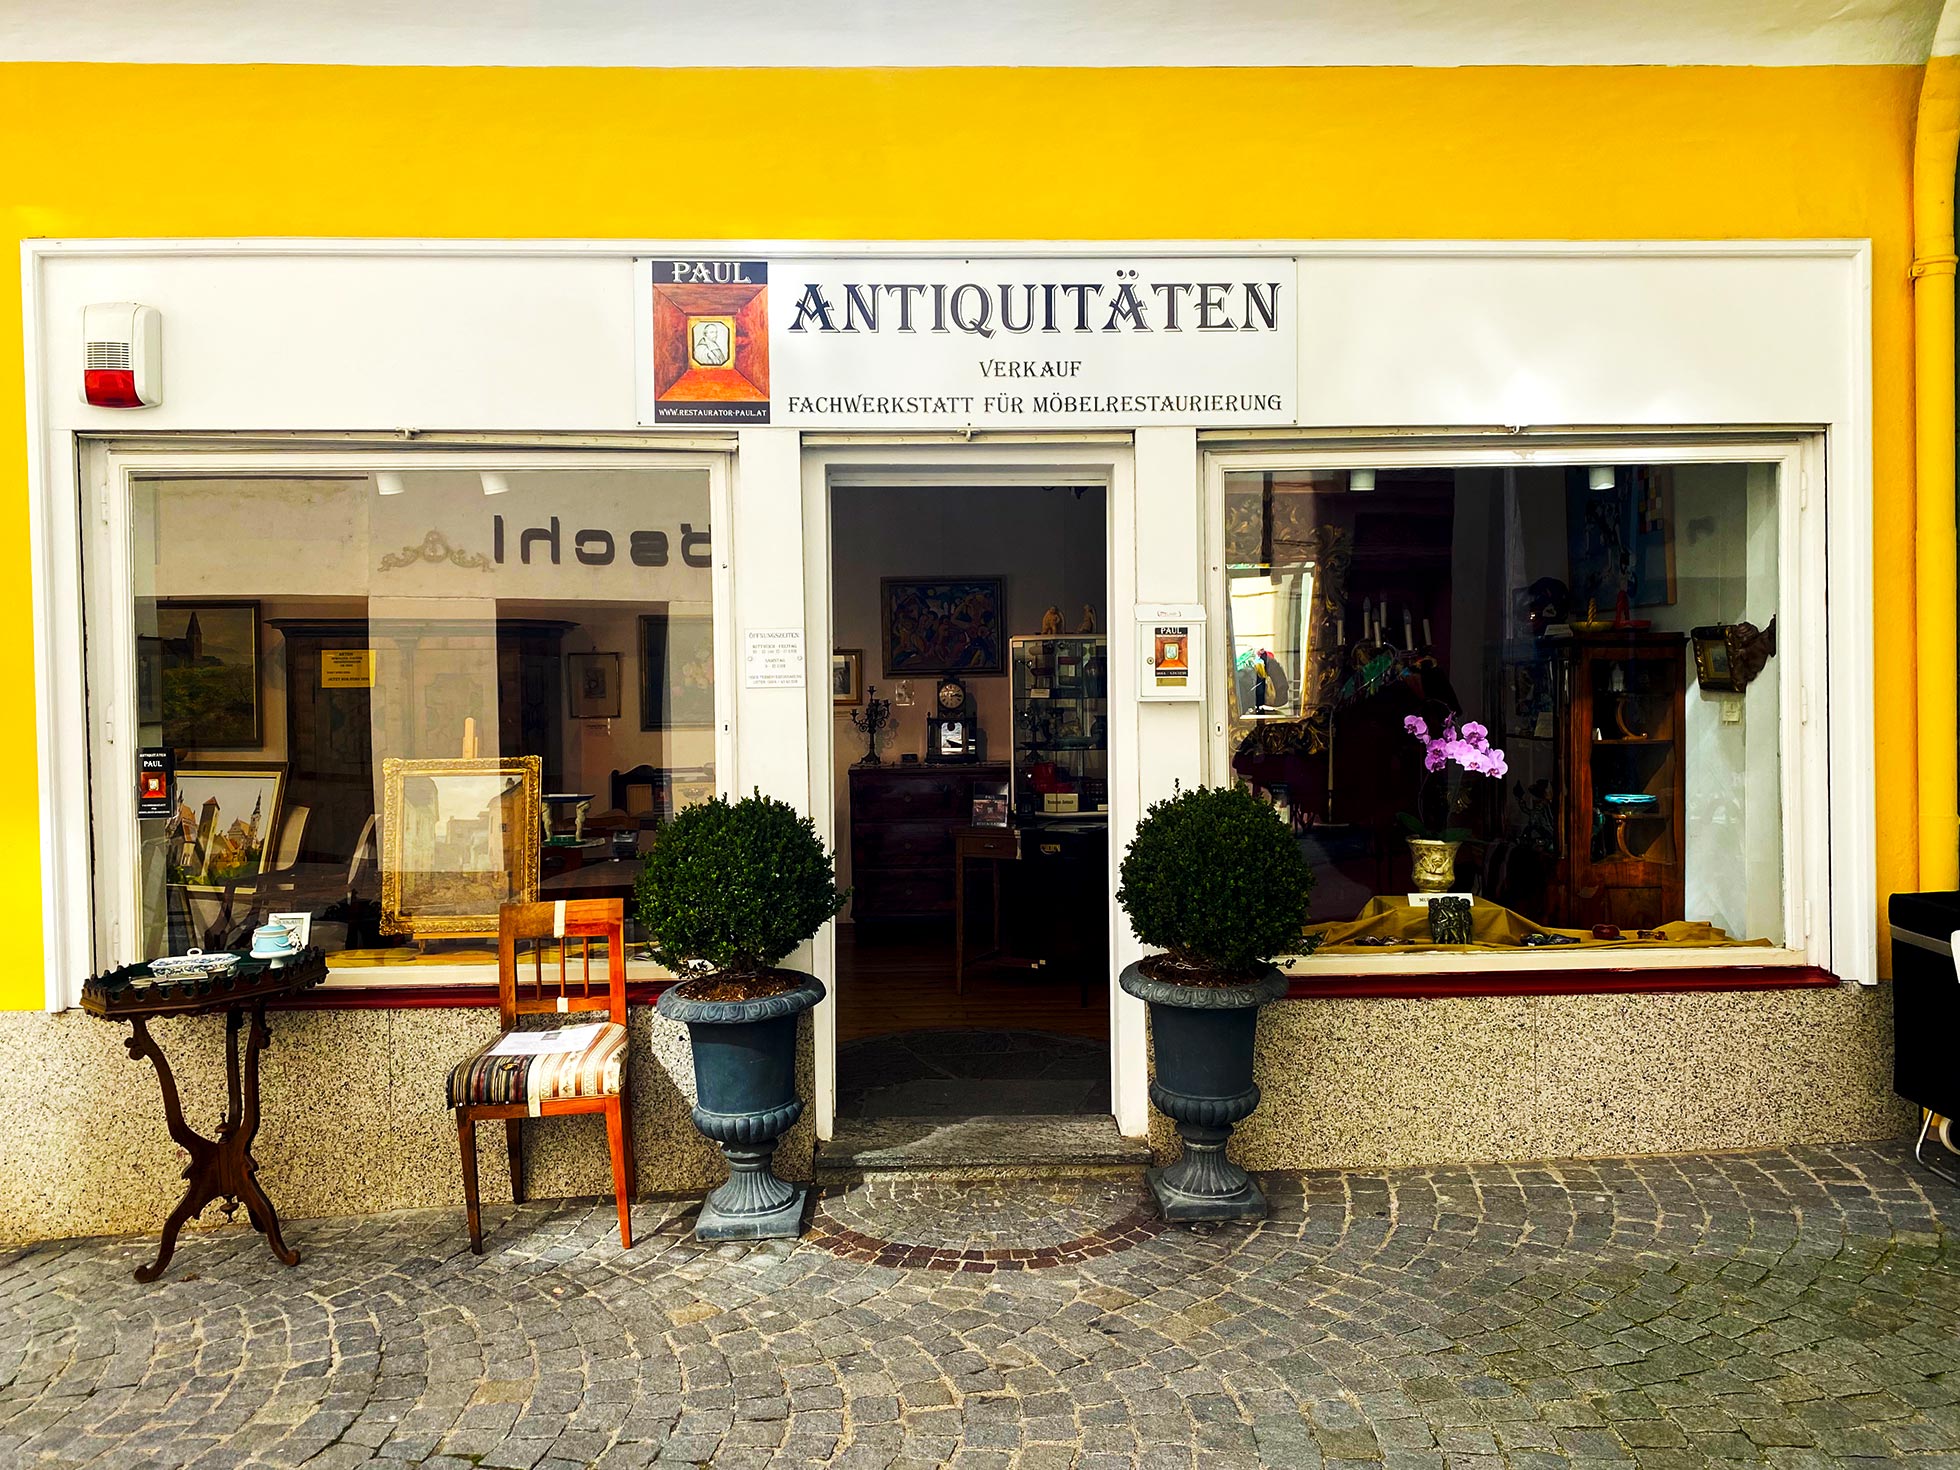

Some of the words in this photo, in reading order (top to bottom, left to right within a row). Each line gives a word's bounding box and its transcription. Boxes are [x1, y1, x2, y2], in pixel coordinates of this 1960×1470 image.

[671, 261, 752, 284] PAUL
[788, 269, 1282, 339] ANTIQUITÄTEN
[979, 359, 1082, 379] VERKAUF
[658, 408, 767, 417] WWW.RESTAURATOR-PAUL.AT
[788, 394, 974, 415] FACHWERKSTATT
[984, 392, 1024, 414] FÜR
[1033, 392, 1282, 414] MÖBELRESTAURIERUNG
[1160, 627, 1182, 635] PAUL
[143, 760, 163, 768] PAUL
